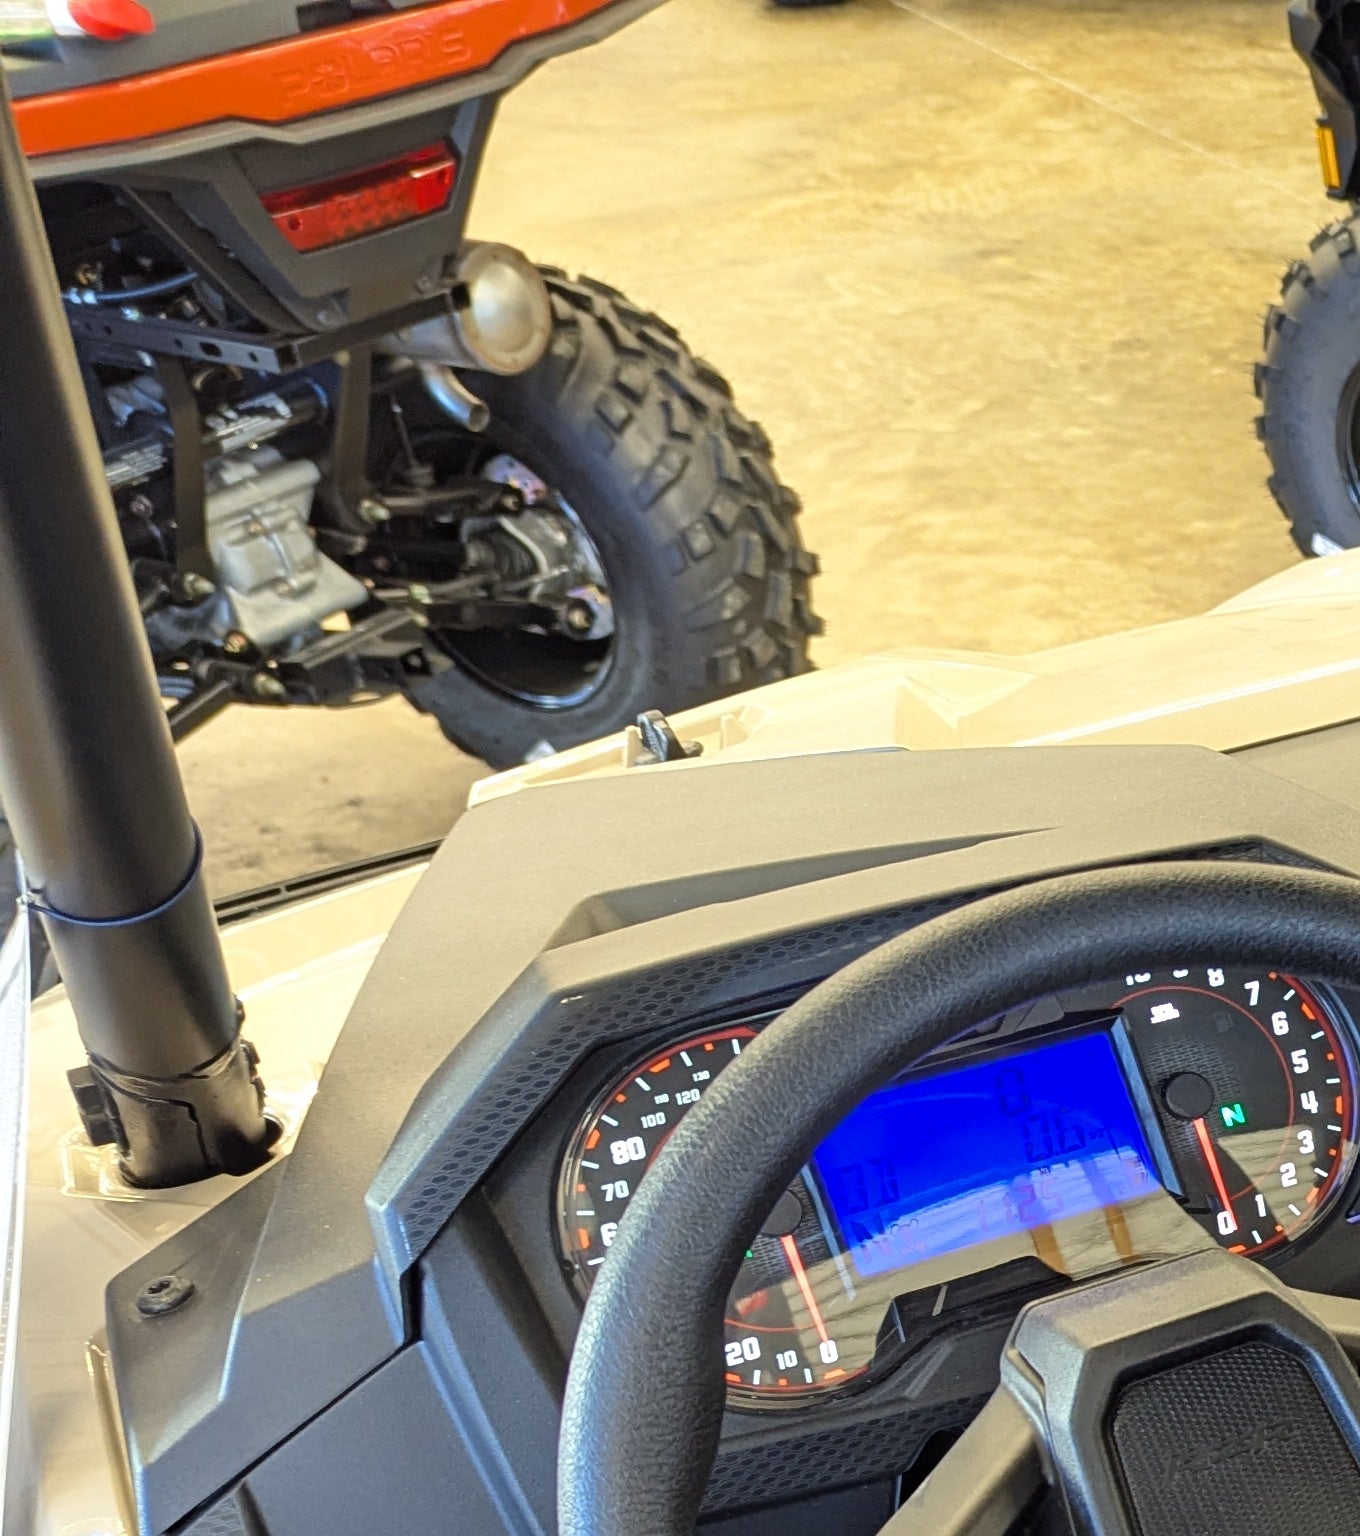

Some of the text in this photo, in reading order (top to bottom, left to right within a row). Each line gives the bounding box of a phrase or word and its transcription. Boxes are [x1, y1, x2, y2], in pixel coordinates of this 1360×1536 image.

[1244, 980, 1261, 1006] 7
[1271, 1011, 1289, 1036] 6
[1291, 1049, 1310, 1074] 5
[675, 1088, 701, 1106] 120
[1300, 1091, 1319, 1114] 4
[640, 1111, 667, 1129] 100
[1220, 1103, 1246, 1127] N
[609, 1136, 648, 1165] 80
[1297, 1129, 1315, 1154] 3
[1279, 1162, 1298, 1188] 2
[601, 1179, 630, 1202] 70
[1255, 1193, 1267, 1218] 1
[600, 1222, 618, 1247] 6
[1217, 1211, 1238, 1237] 0
[724, 1336, 762, 1367] 20
[775, 1350, 798, 1371] 10
[819, 1339, 840, 1364] 0
